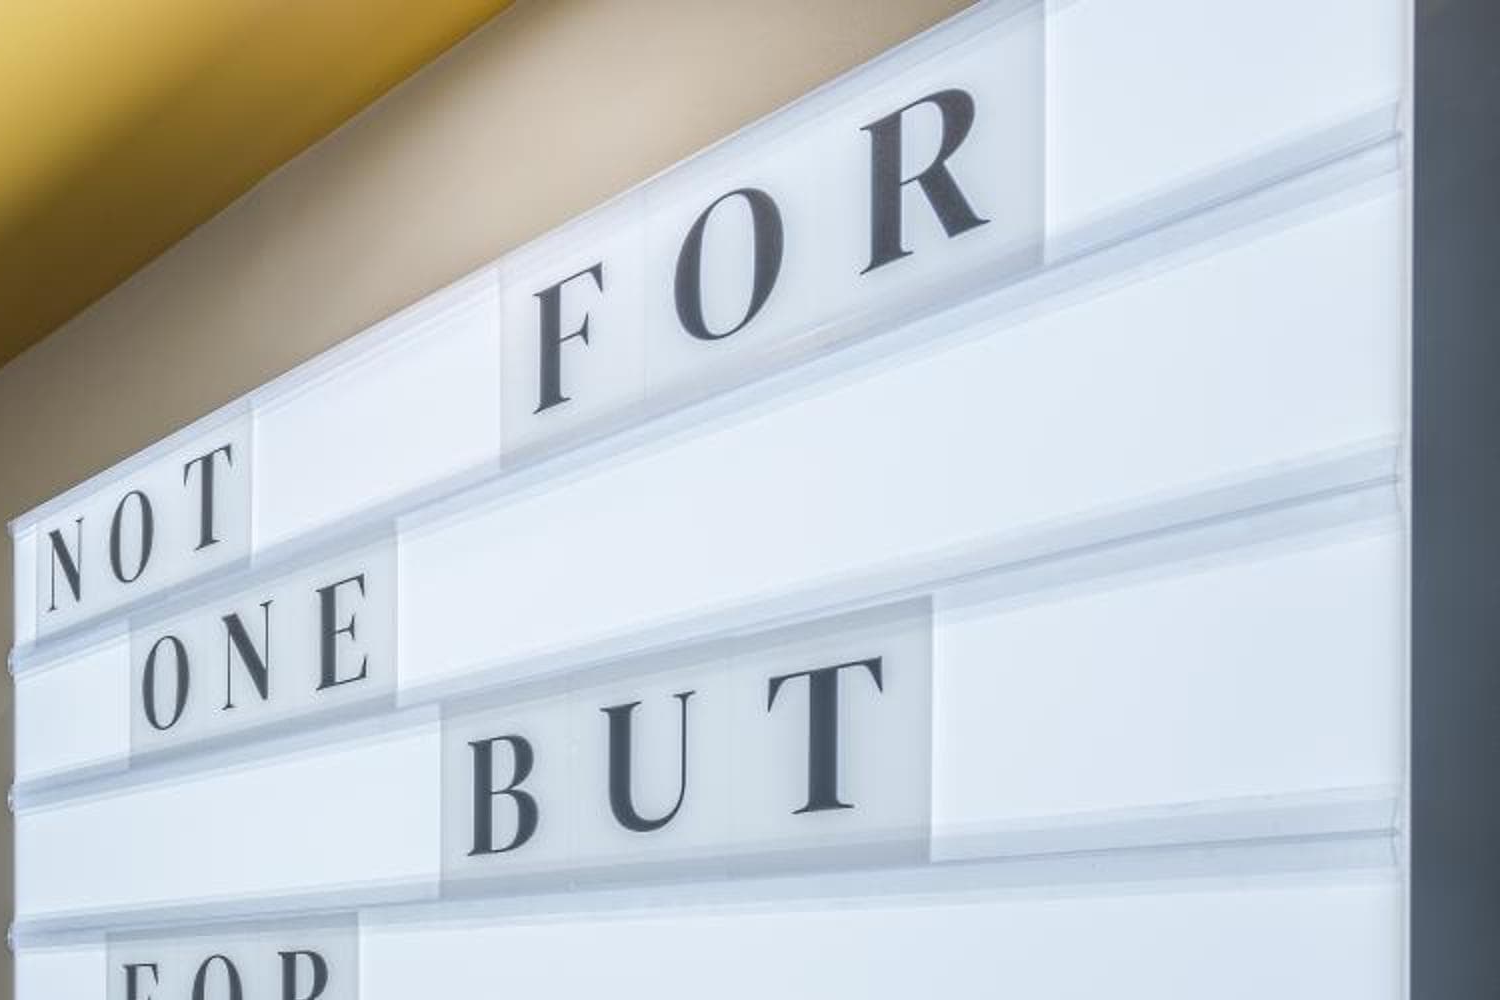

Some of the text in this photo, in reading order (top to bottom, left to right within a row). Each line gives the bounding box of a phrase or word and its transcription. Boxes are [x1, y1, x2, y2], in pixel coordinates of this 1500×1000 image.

[44, 87, 992, 614] NOT FOR
[141, 573, 369, 732] ONE
[466, 654, 885, 858] BUT
